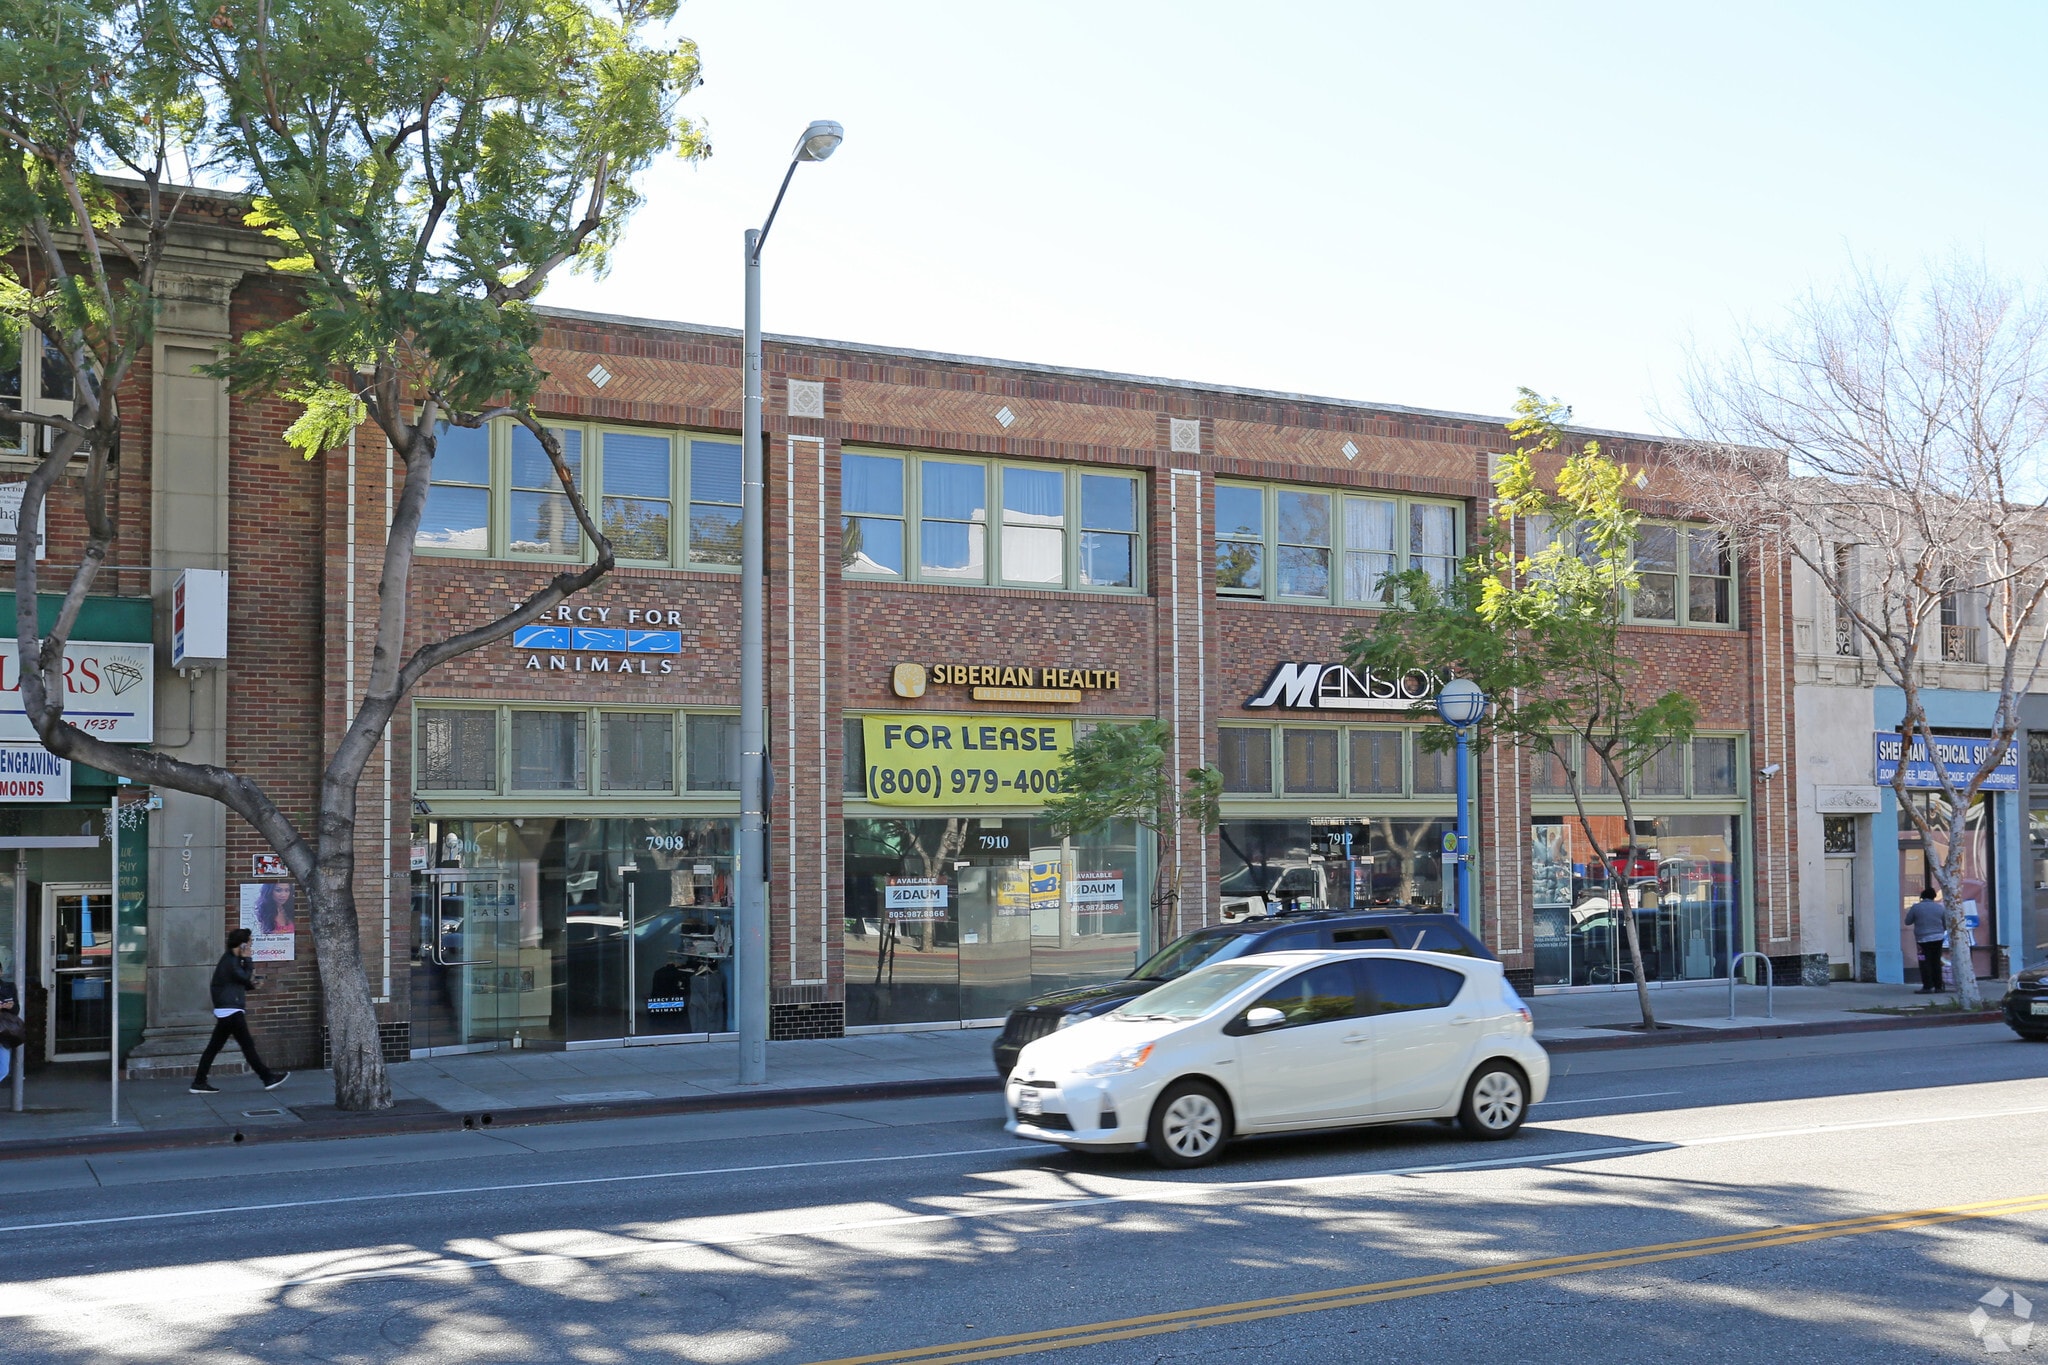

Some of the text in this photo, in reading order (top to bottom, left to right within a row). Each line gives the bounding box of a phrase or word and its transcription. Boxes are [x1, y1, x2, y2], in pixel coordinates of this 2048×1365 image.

[629, 609, 682, 626] FOR
[525, 654, 674, 675] ANIMALS
[932, 663, 1120, 690] SIBERIAN HEALTH
[977, 688, 1078, 701] INTERNATIONAL
[84, 718, 118, 731] 1938
[884, 724, 1058, 751] FOR LEASE
[1879, 740, 2018, 767] SHEAN EDICAL SUIES
[1, 749, 61, 777] ENGRAVING
[869, 764, 942, 799] (800)
[450, 838, 481, 854] 906
[645, 835, 684, 851] 7908
[978, 835, 1009, 849] 7910
[1327, 832, 1354, 845] 7912
[902, 889, 940, 900] DAUM
[1081, 883, 1116, 894] DAUM
